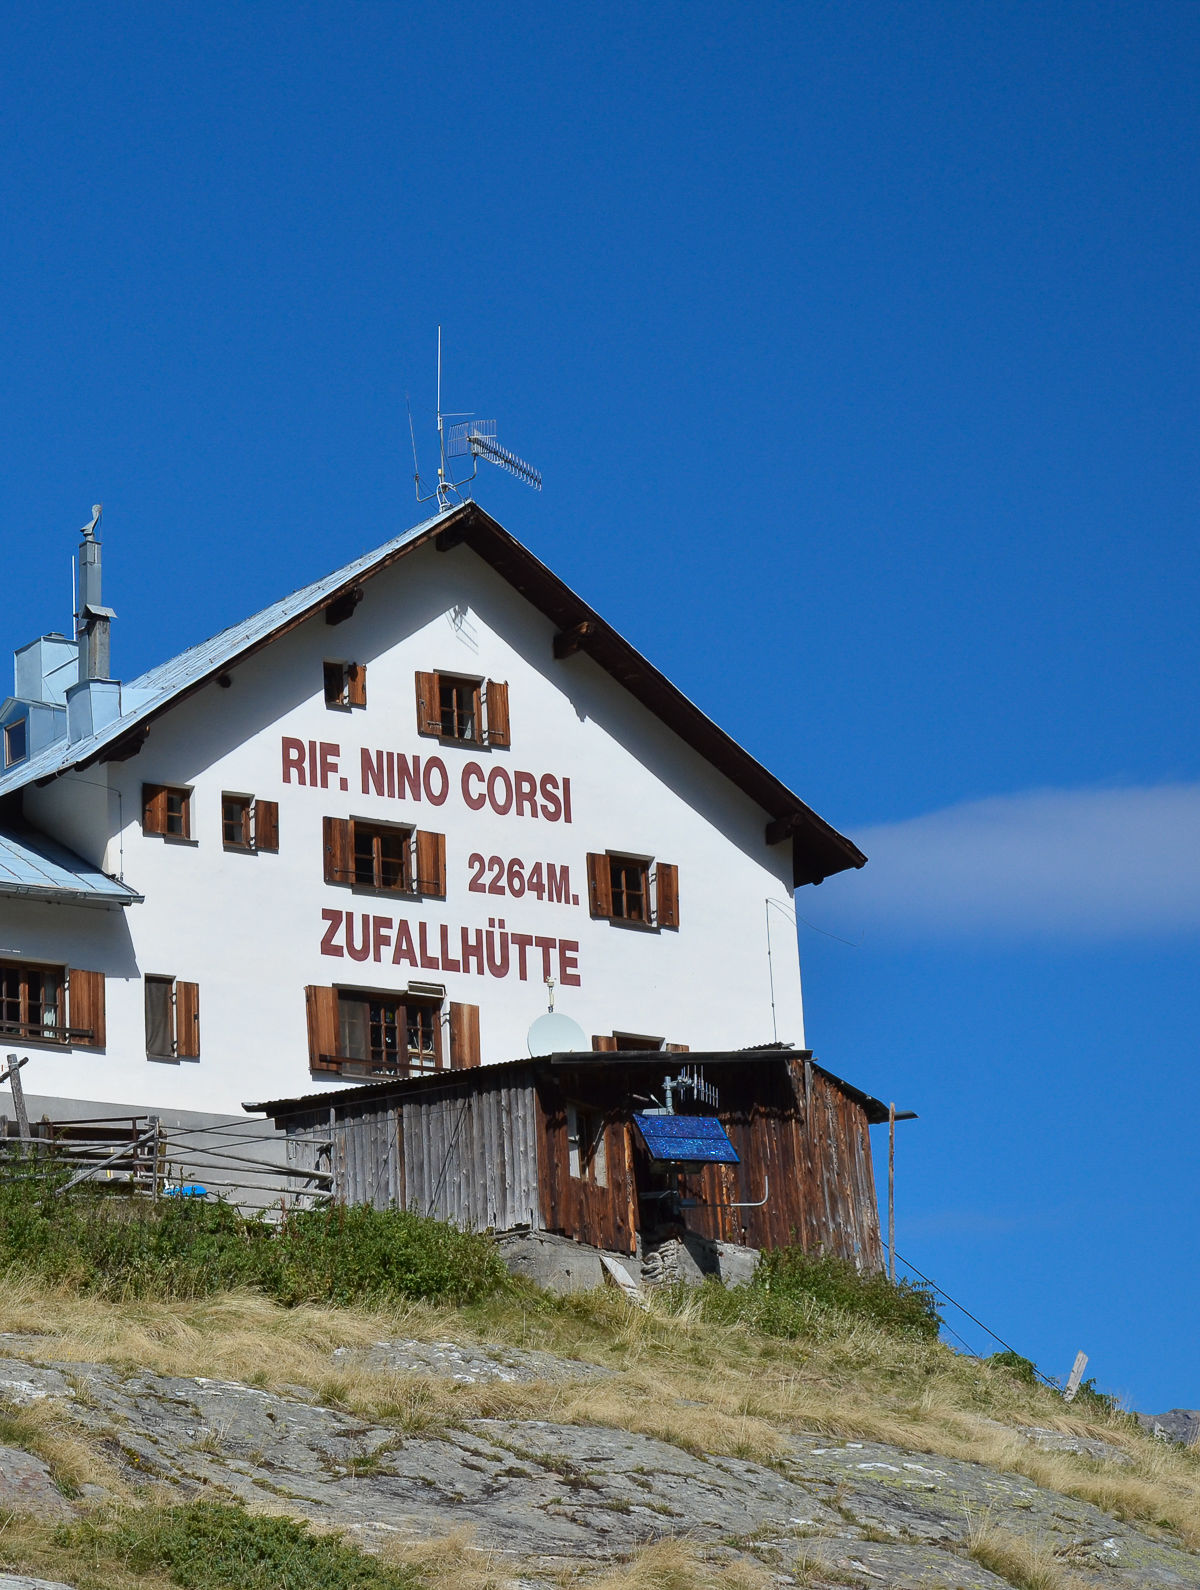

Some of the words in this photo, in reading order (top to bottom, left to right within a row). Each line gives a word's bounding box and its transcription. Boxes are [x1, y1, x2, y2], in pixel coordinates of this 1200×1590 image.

[281, 736, 349, 791] RIF.
[360, 747, 449, 806] NINO
[460, 761, 573, 823] CORSI
[468, 852, 580, 906] 2264M.
[320, 907, 581, 987] ZUFALLHÜTTE
